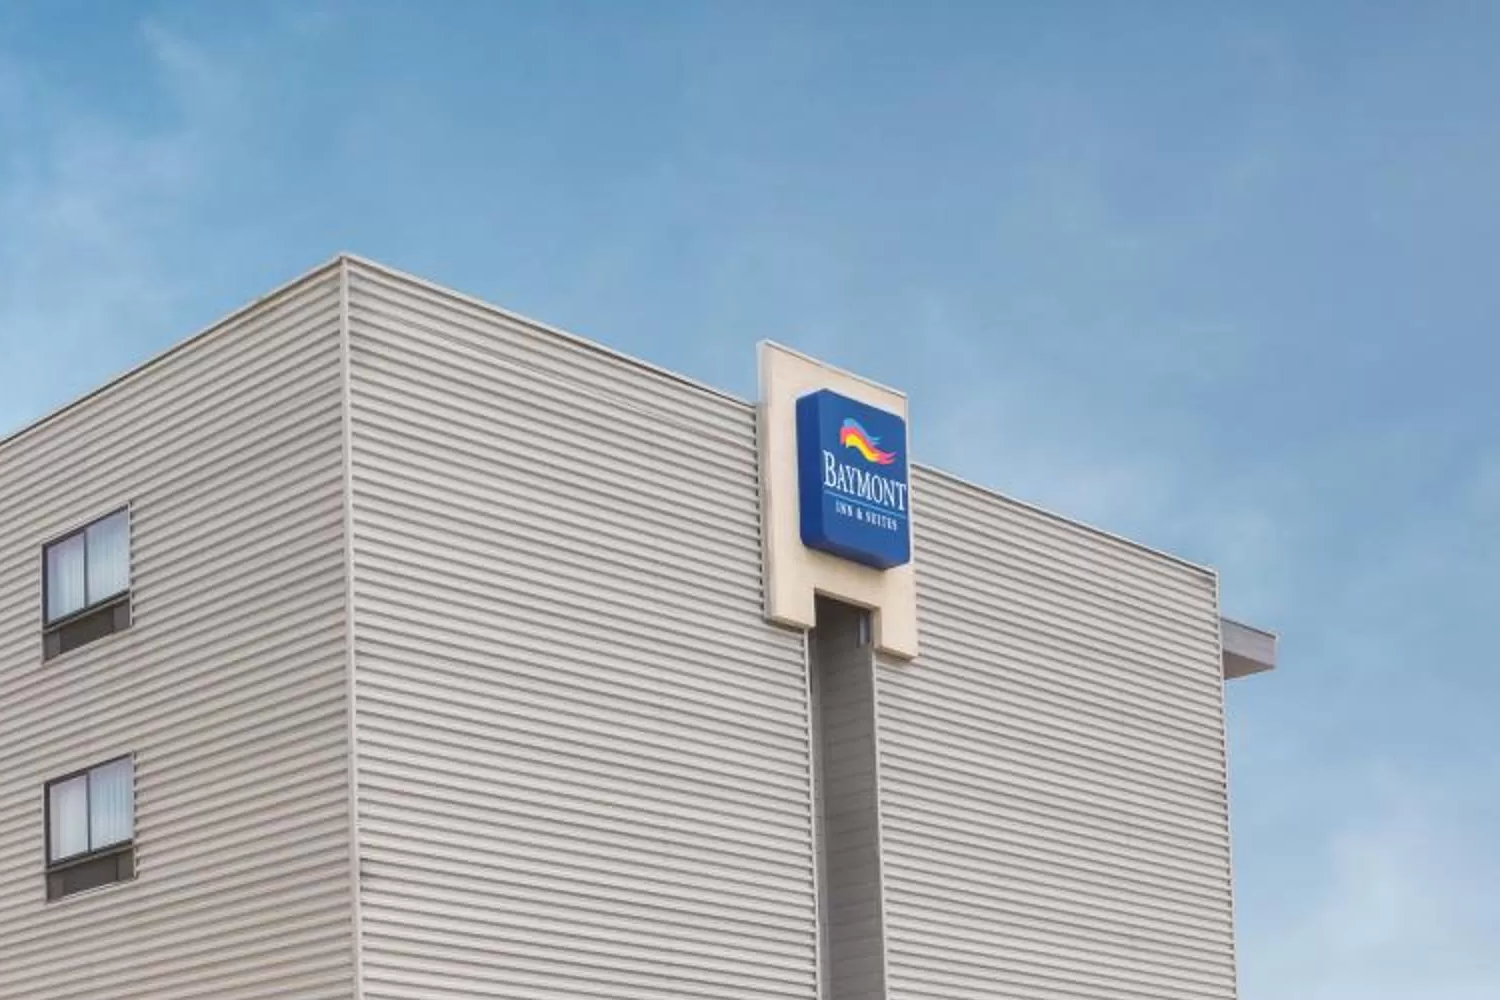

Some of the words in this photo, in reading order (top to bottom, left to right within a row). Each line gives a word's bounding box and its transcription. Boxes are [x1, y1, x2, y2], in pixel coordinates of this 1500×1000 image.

[822, 450, 907, 511] BAYMONT
[835, 501, 853, 516] INN
[866, 511, 897, 531] SUITES
